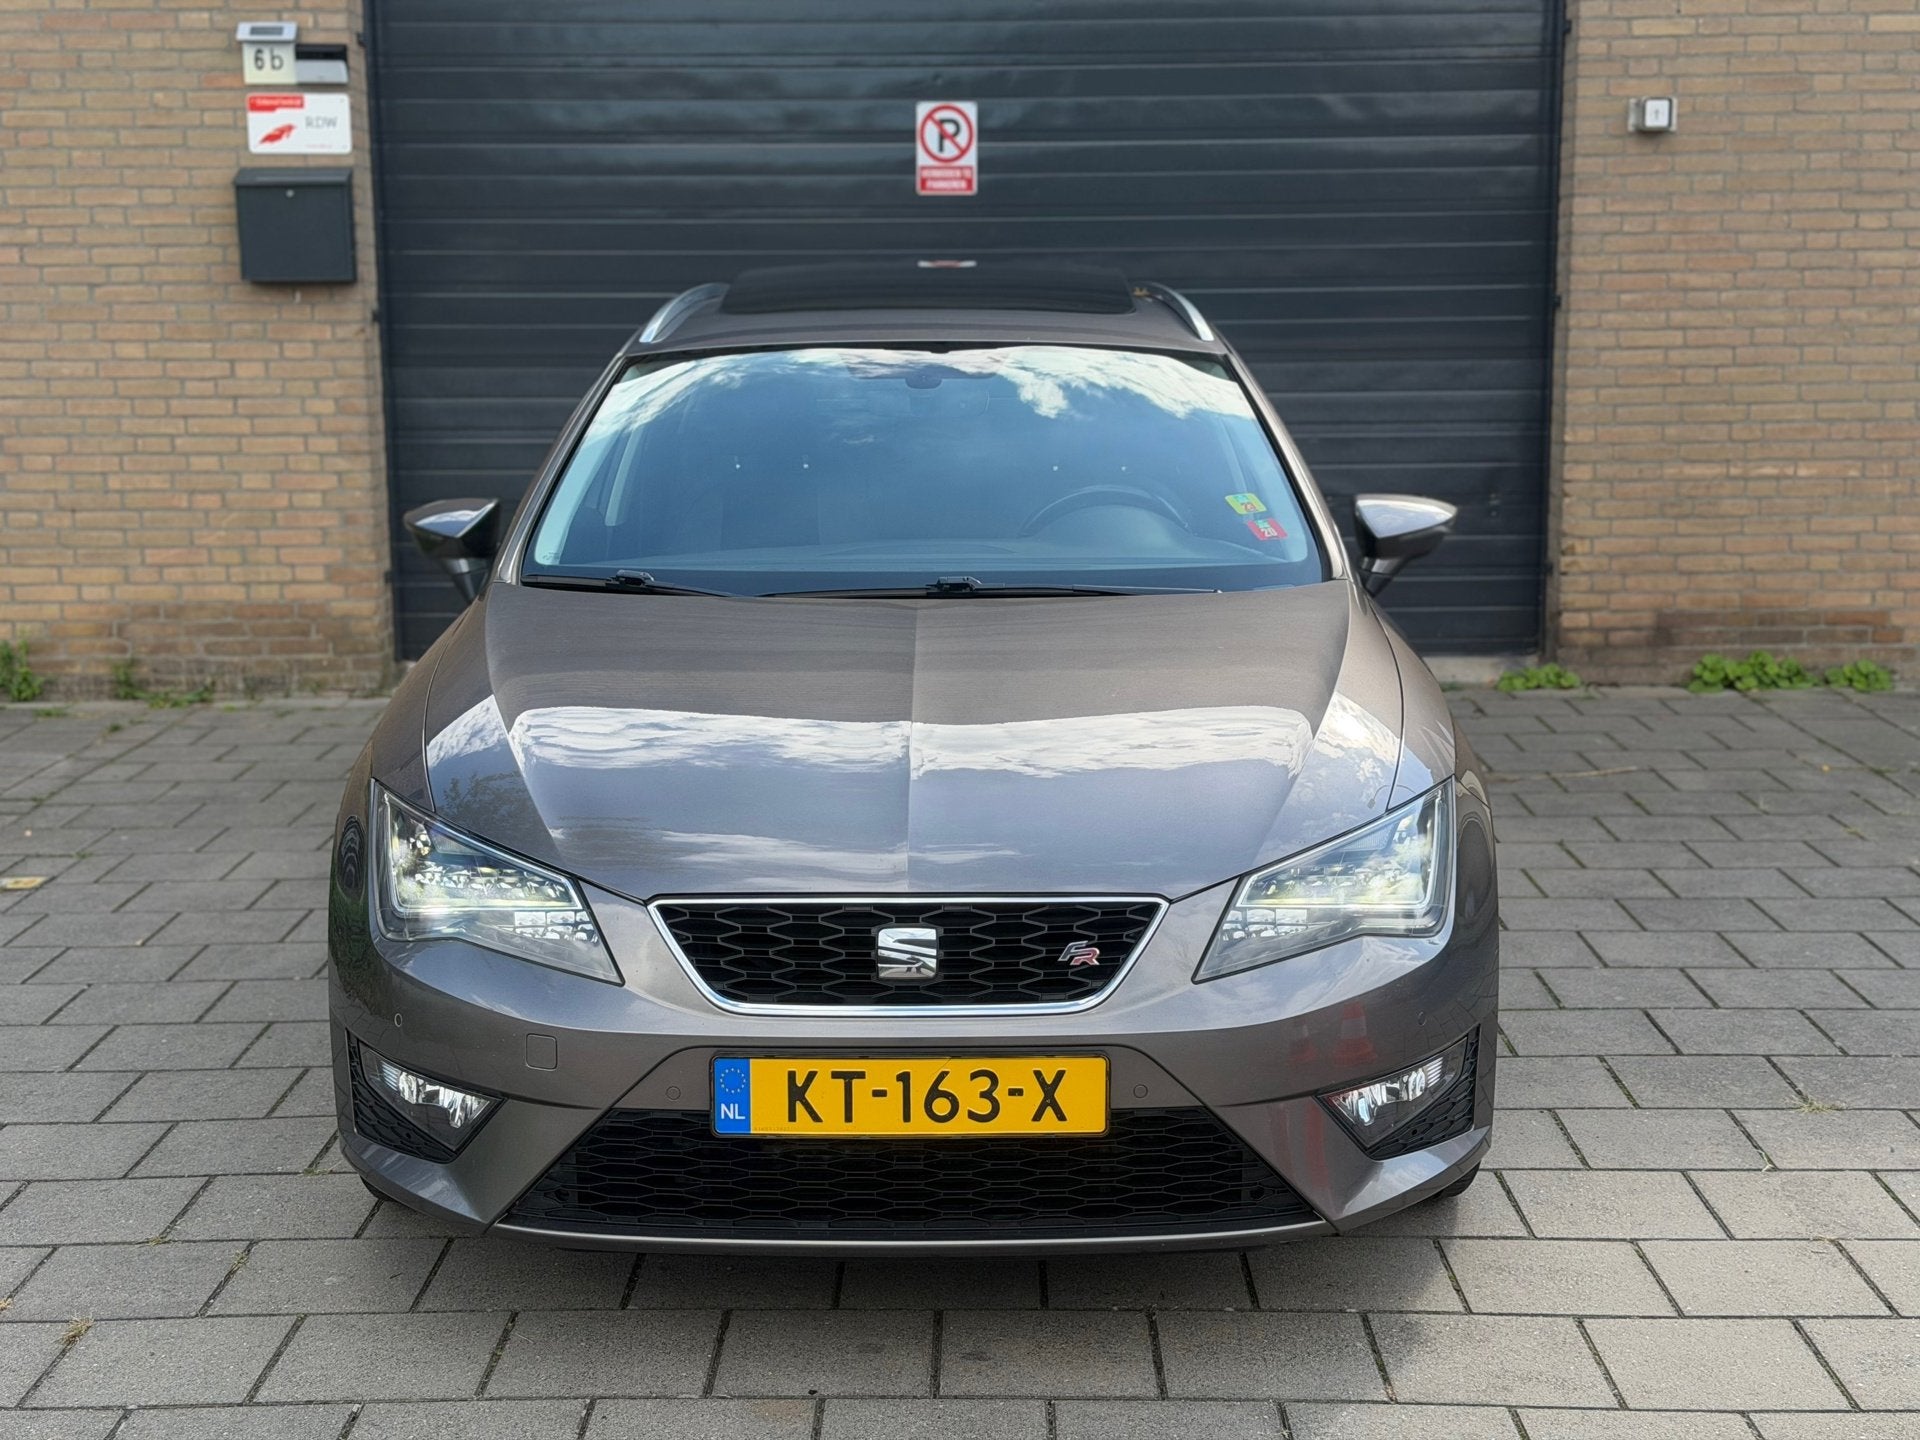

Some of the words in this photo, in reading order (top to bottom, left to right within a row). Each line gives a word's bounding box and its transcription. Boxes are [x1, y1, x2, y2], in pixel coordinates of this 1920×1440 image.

[1057, 940, 1100, 966] FR
[787, 1069, 1068, 1123] KT-163-X
[720, 1103, 746, 1120] NL
